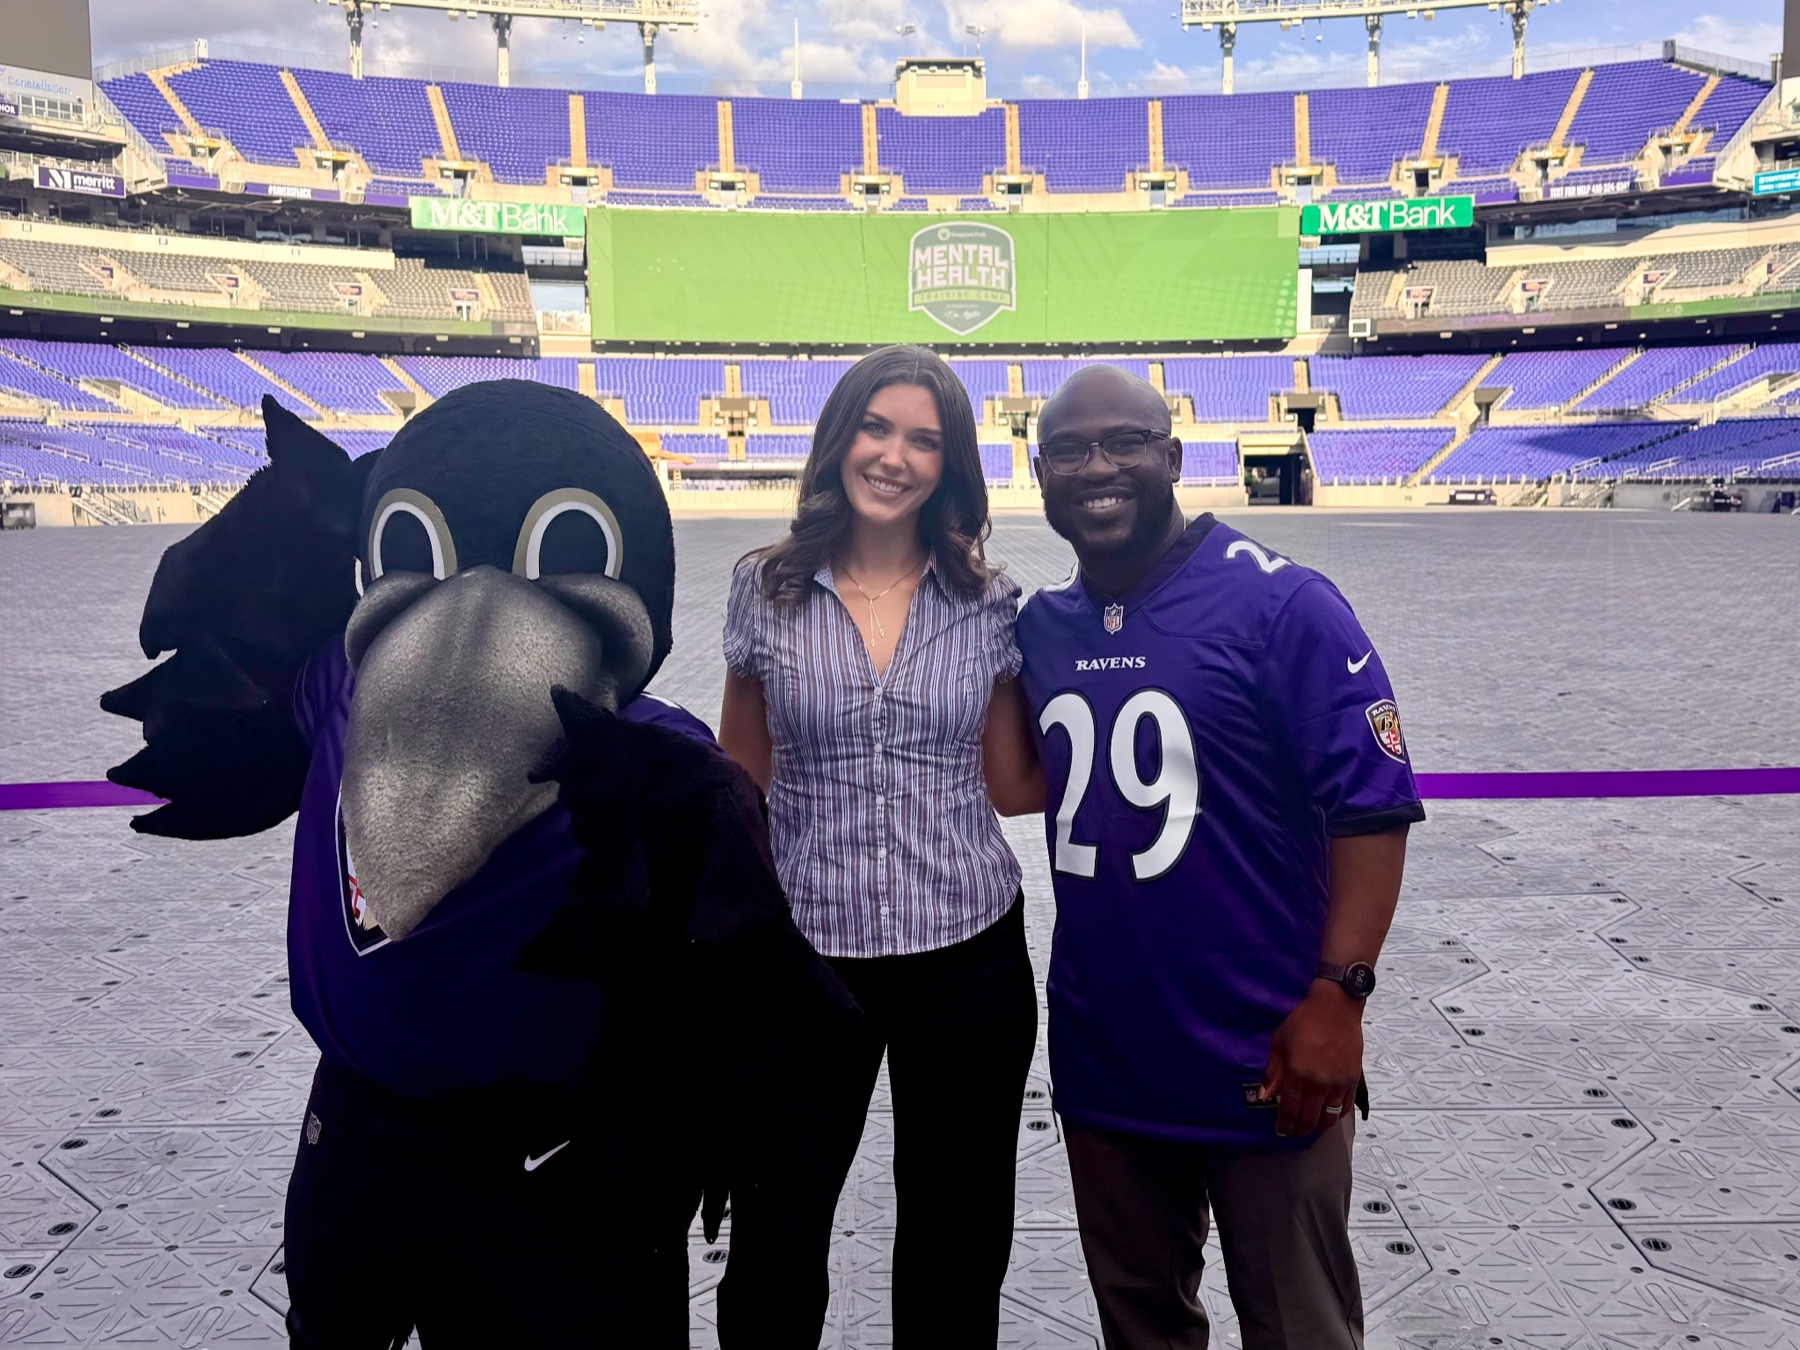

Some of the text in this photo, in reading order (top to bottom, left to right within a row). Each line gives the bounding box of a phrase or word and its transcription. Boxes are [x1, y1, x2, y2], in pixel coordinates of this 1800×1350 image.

[73, 175, 115, 190] merritt
[429, 200, 569, 233] M&T Bank
[1318, 199, 1456, 232] M&T Bank
[914, 243, 1009, 269] MENTAL
[916, 265, 1006, 289] HEALTH
[1075, 656, 1147, 672] RAVENS
[1038, 687, 1200, 883] 29
